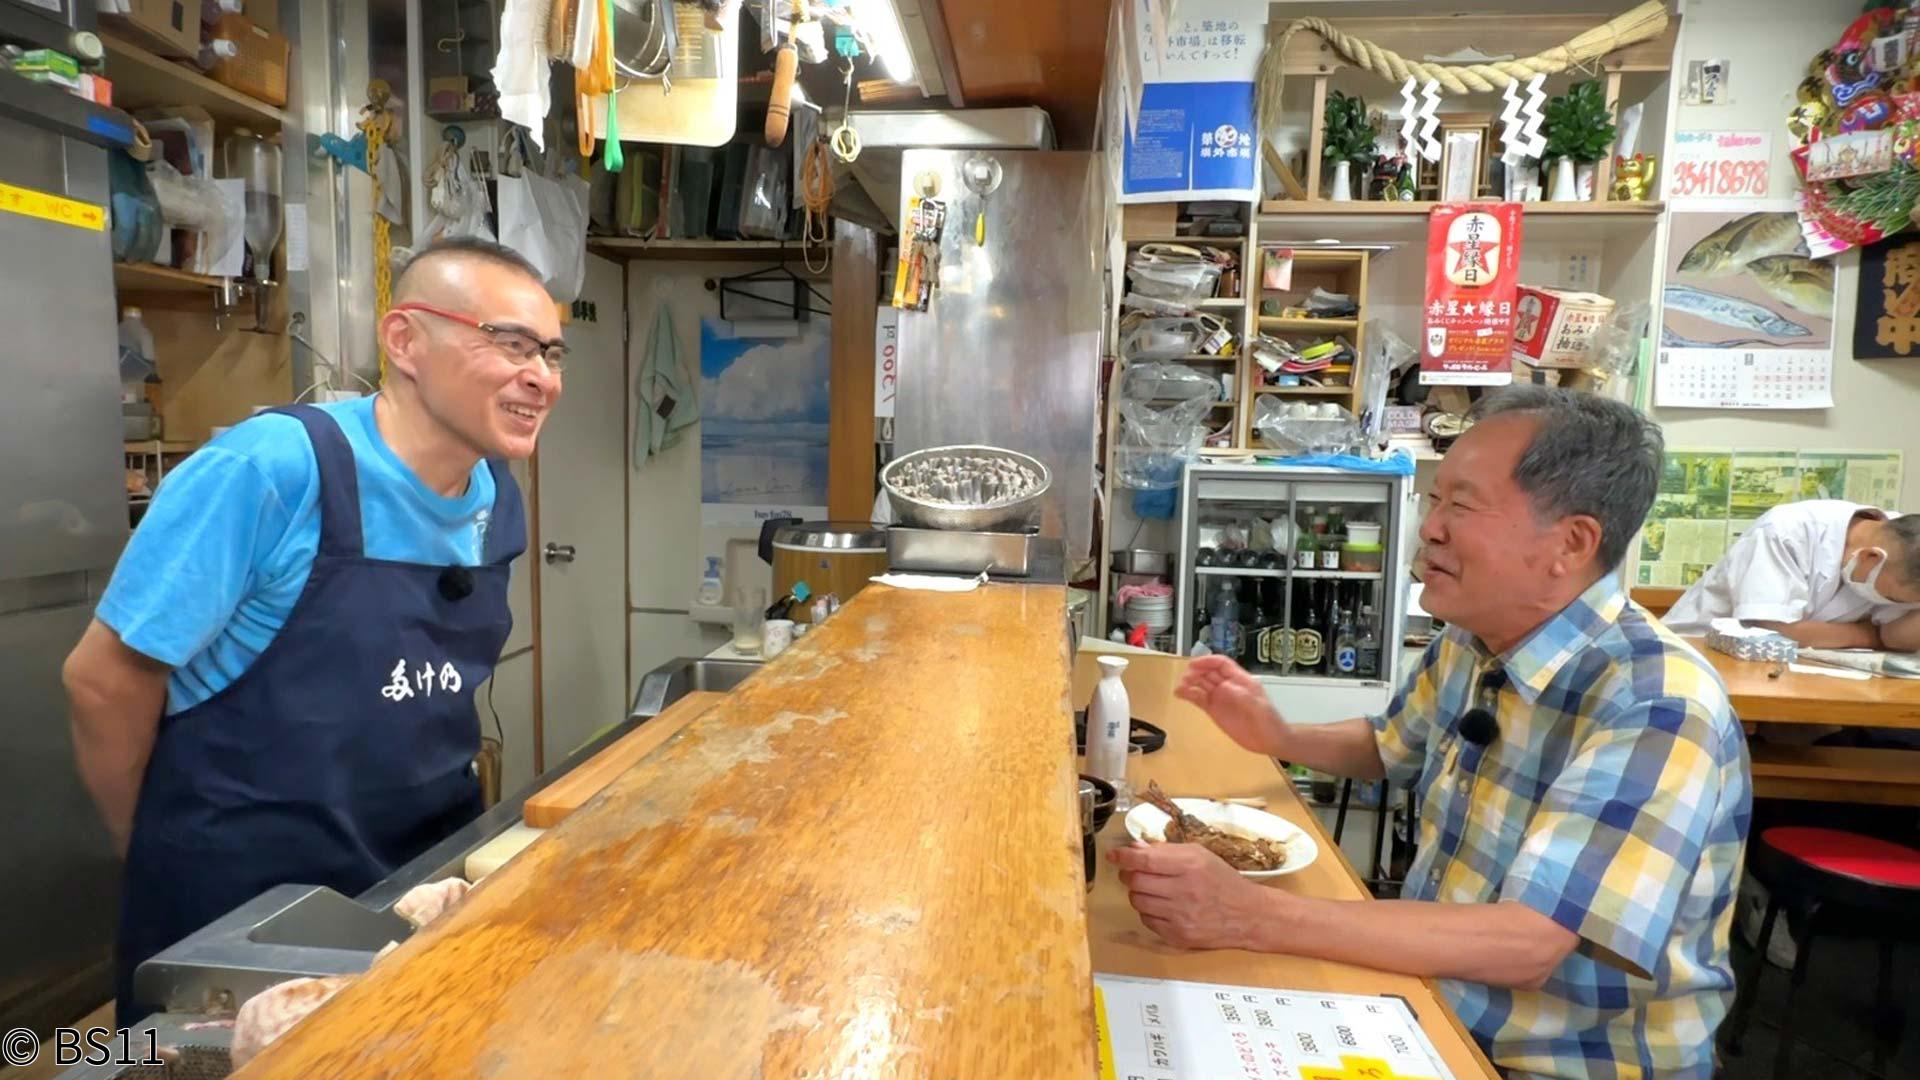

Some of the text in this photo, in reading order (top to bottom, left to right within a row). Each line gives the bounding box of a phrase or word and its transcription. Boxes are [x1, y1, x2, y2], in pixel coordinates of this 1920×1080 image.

[1671, 160, 1769, 195] 35418698
[1464, 214, 1485, 284] 赤星縁日
[1215, 992, 1231, 1001] 円
[1242, 994, 1259, 1003] 円
[1320, 1000, 1337, 1010] 円
[1221, 1004, 1241, 1022] 3500
[1254, 1009, 1274, 1027] 3800
[1275, 997, 1319, 1053] 3800 円
[1366, 1004, 1410, 1055] 7000 円
[1336, 1025, 1357, 1047] 6500
